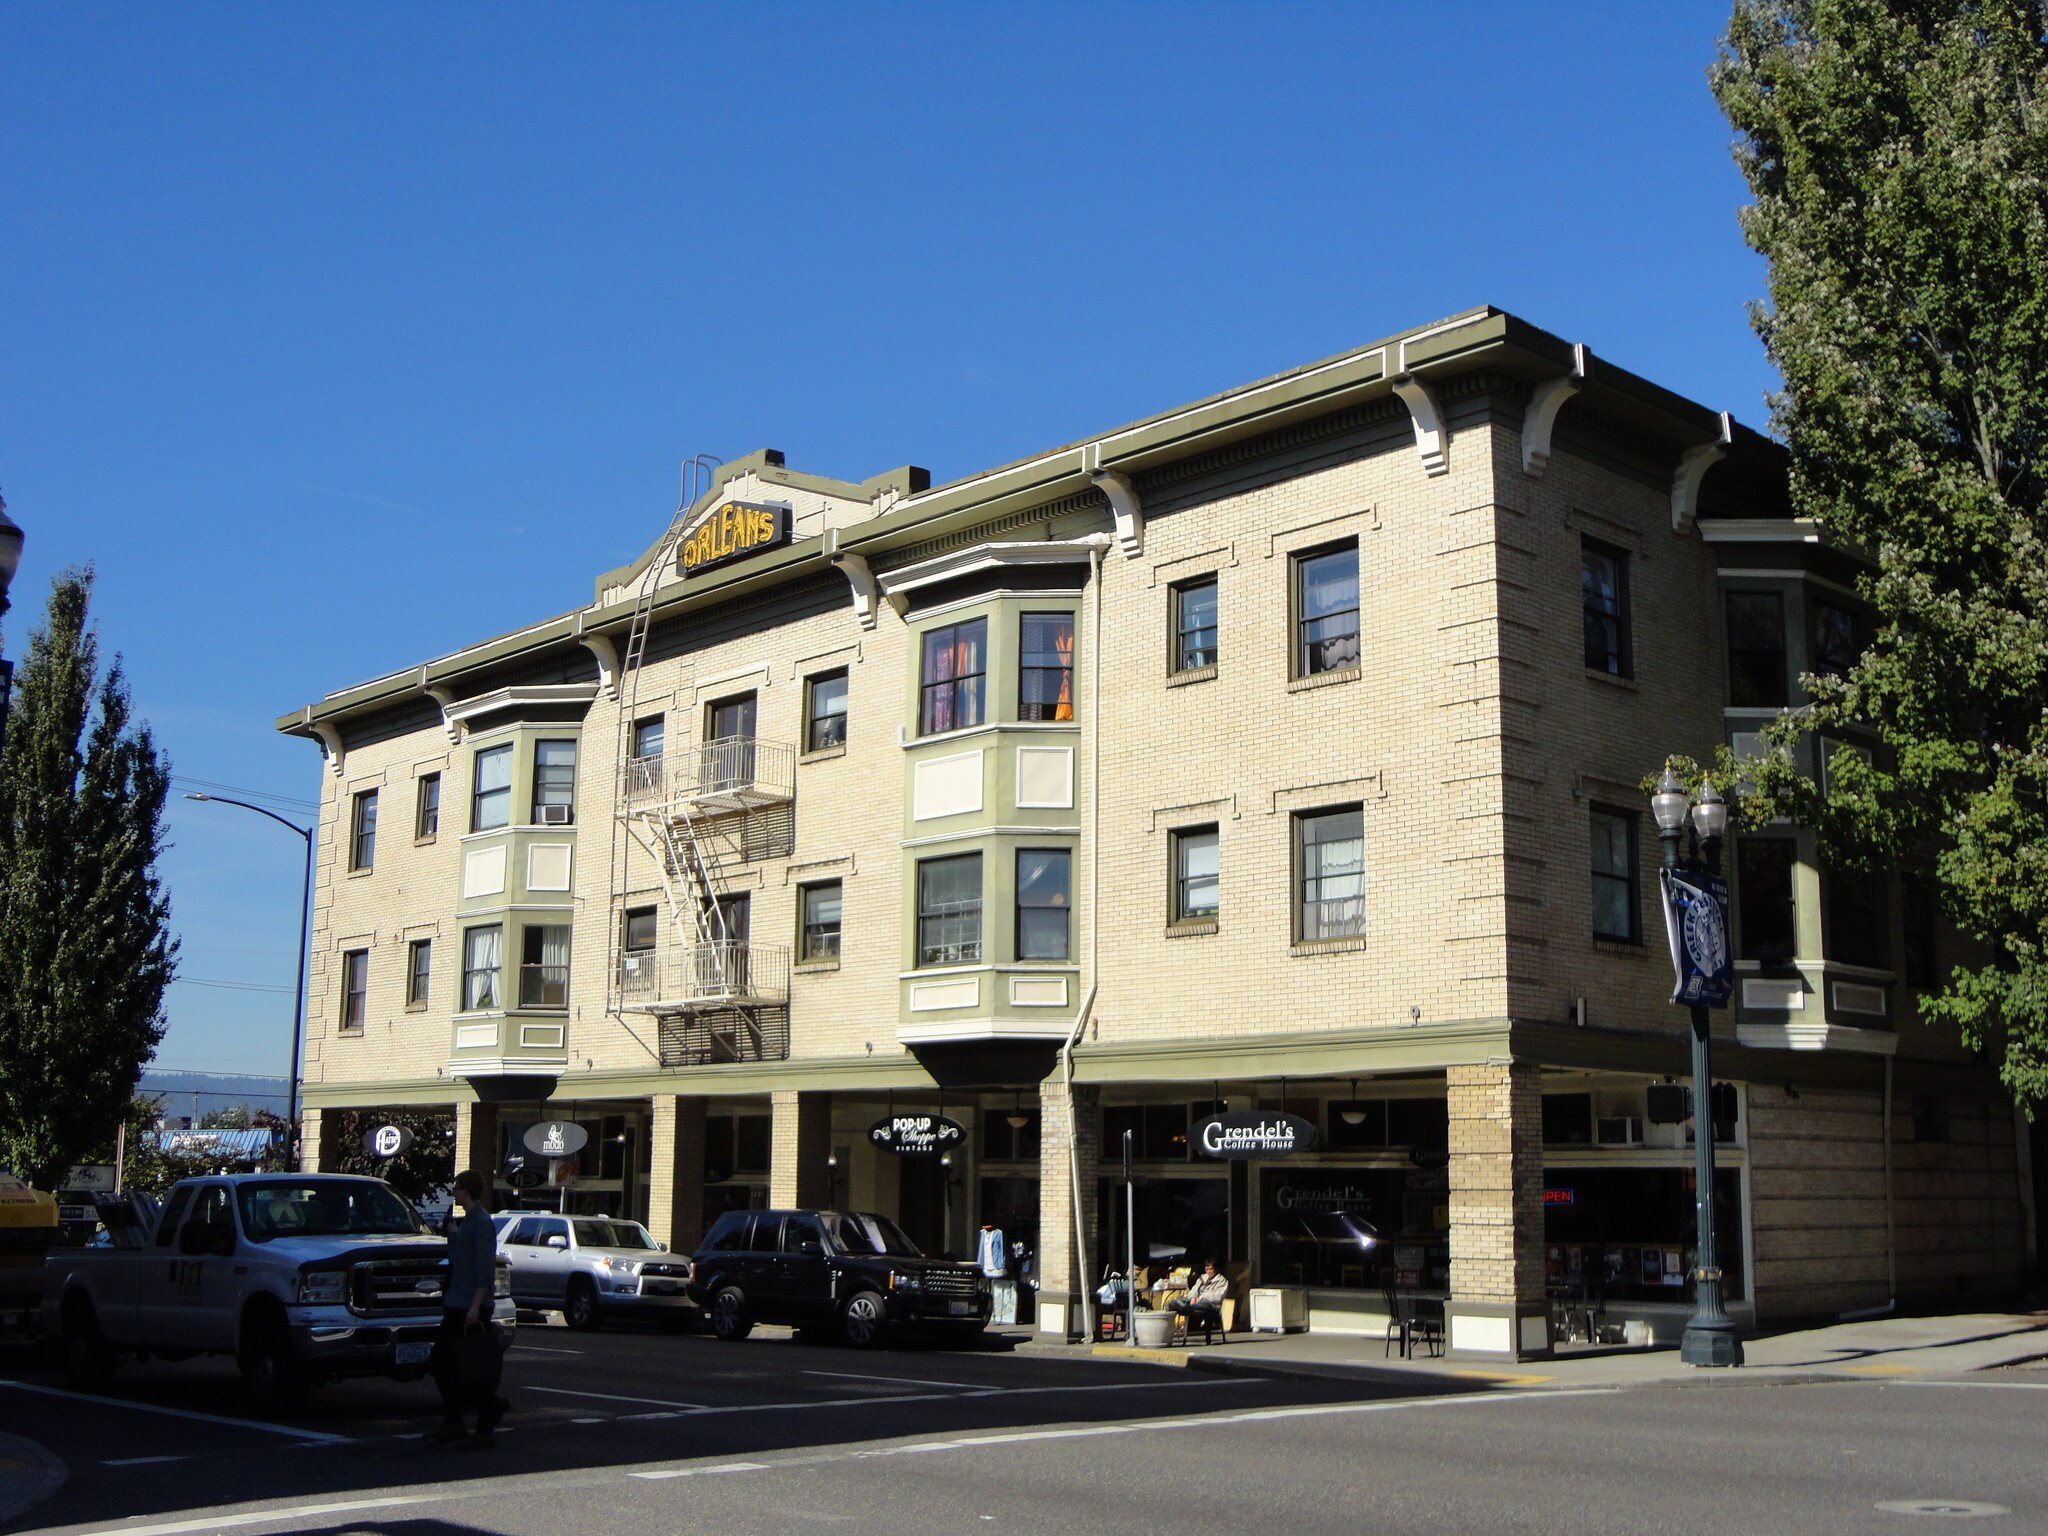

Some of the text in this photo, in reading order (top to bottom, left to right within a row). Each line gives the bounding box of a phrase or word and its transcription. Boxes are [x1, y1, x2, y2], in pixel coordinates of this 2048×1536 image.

[682, 503, 775, 568] ORLEANS
[1686, 912, 1702, 962] GREEK
[901, 1128, 937, 1145] Shoppe
[1203, 1120, 1294, 1150] Grendel's
[1224, 1139, 1293, 1149] Coffee House
[1276, 1185, 1365, 1209] Grendel's
[1336, 1201, 1372, 1212] House
[1543, 1191, 1571, 1202] PEN
